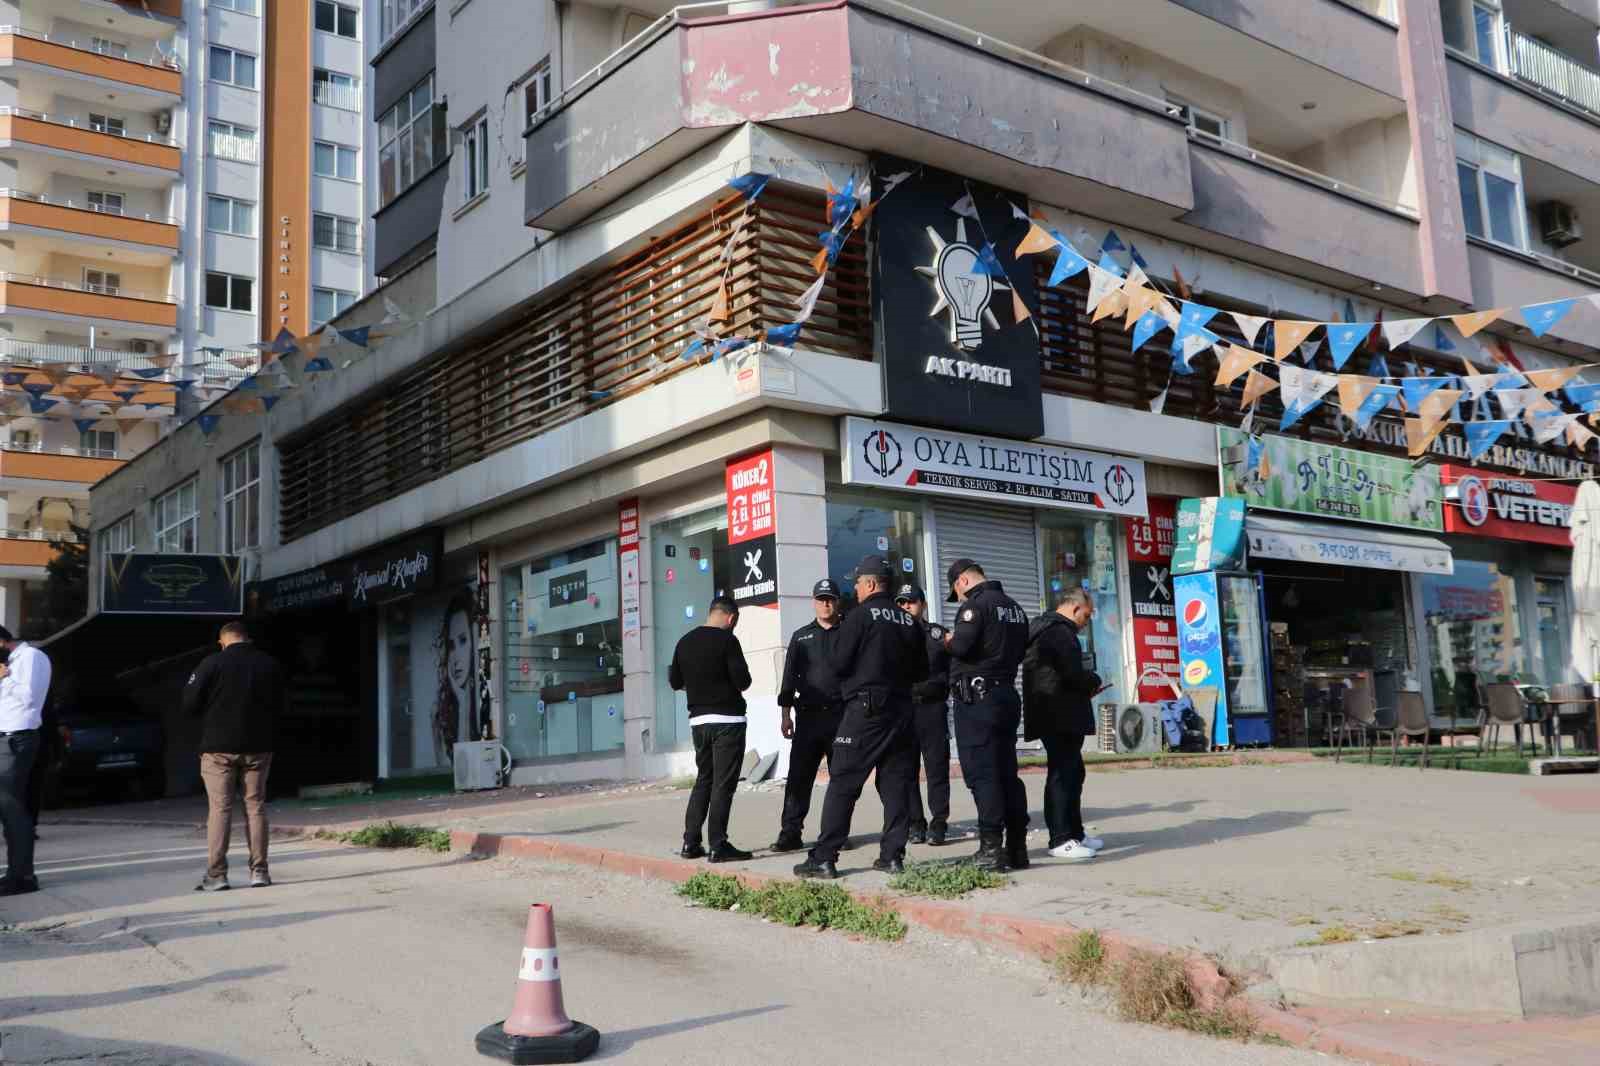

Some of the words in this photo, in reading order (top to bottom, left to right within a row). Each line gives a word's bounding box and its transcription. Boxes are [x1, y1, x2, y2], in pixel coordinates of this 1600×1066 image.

[925, 355, 956, 377] AK
[913, 436, 971, 466] OYA
[979, 439, 1095, 486] İLETİŞİM
[964, 477, 998, 492] SERVİS
[1016, 483, 1028, 494] EL
[1030, 484, 1054, 498] ALIM
[1061, 490, 1089, 503] SATIM
[1492, 478, 1536, 495] ATHENA
